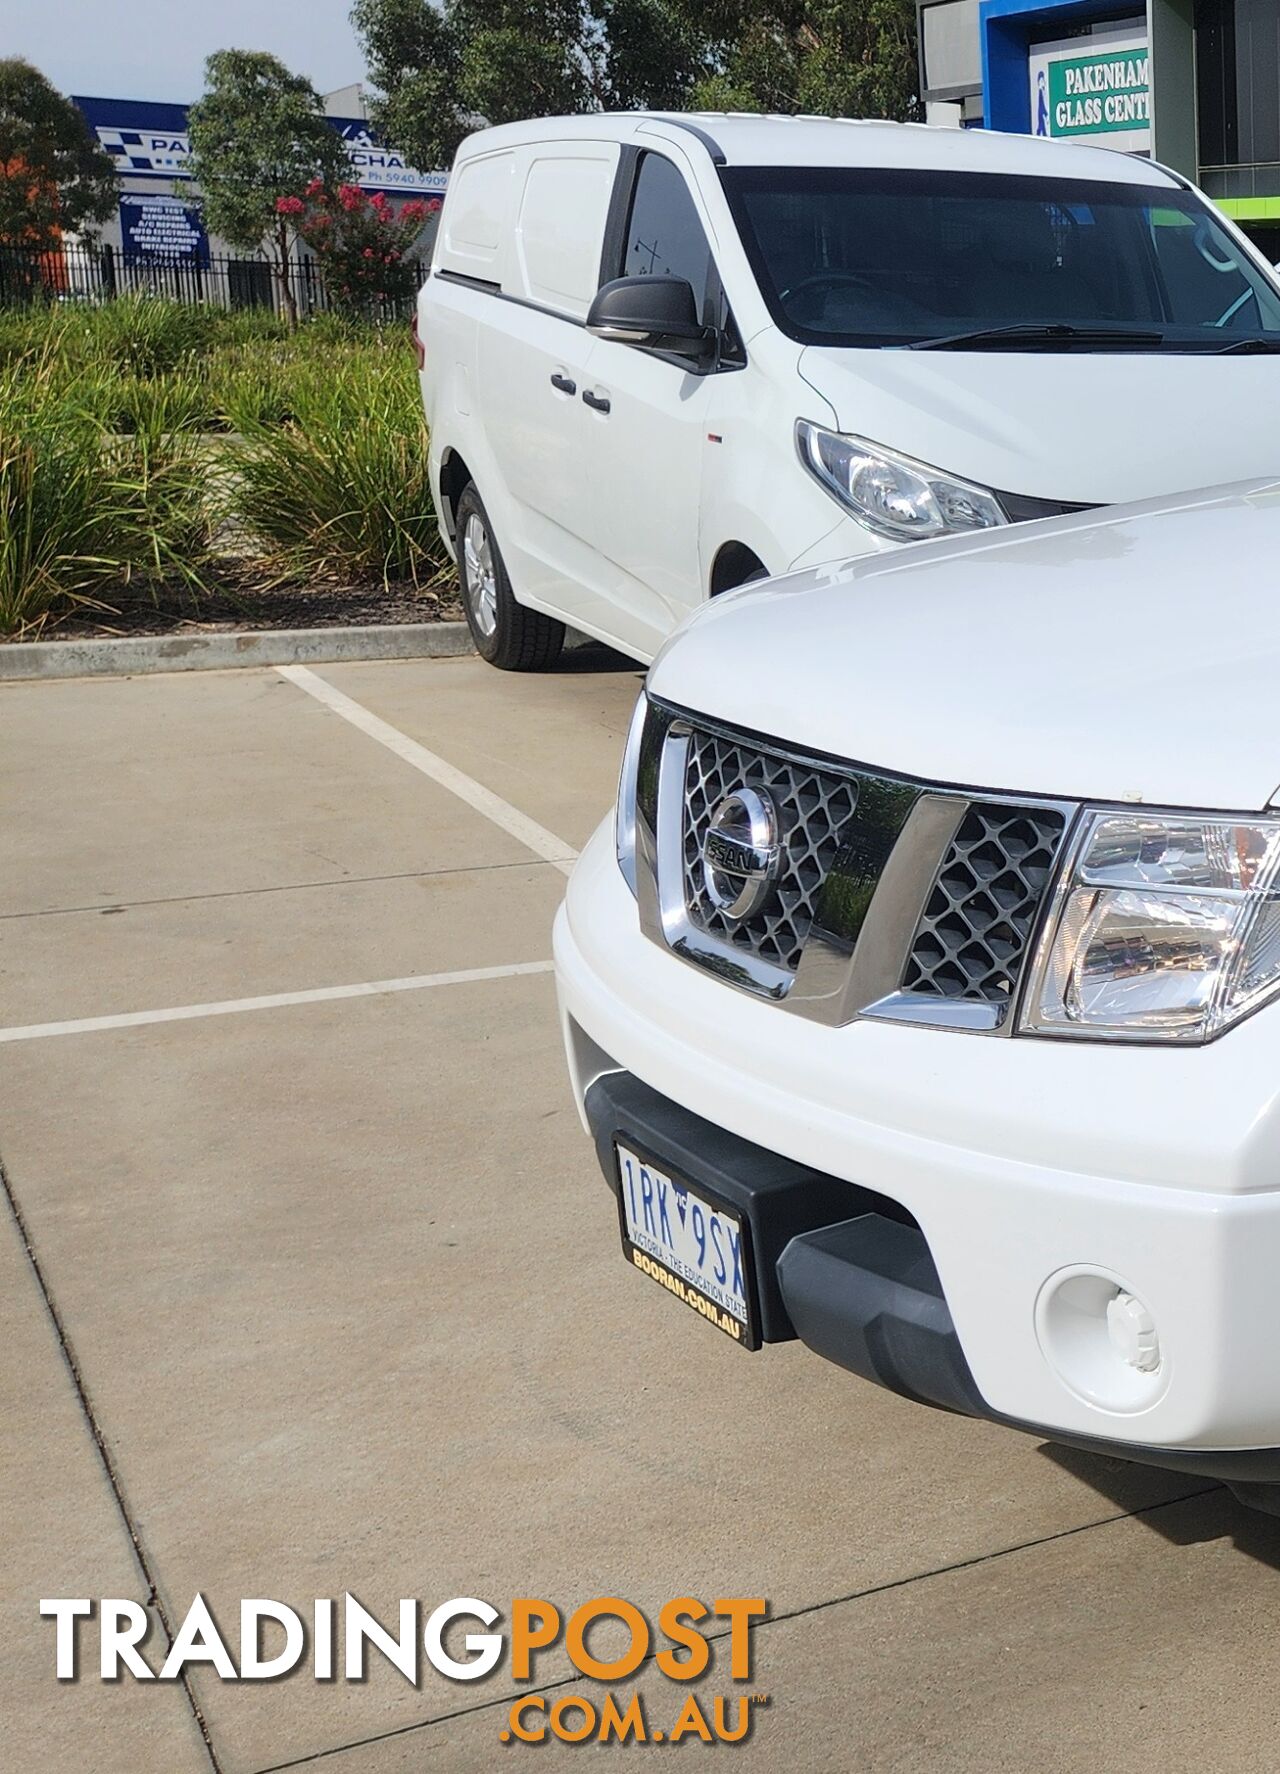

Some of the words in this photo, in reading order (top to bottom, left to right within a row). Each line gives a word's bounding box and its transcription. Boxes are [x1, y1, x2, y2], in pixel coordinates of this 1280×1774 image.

[1065, 58, 1149, 95] PAKENHAM
[1056, 98, 1102, 128] GLASS
[152, 139, 192, 153] PA
[386, 173, 415, 184] 5940
[418, 176, 447, 186] 9909
[625, 1159, 675, 1251] 1RK
[692, 1204, 745, 1296] 9SX
[632, 1229, 663, 1260] VICTORIA
[669, 1254, 684, 1274] THE
[684, 1265, 723, 1303] EDUCATION
[725, 1292, 748, 1319] STATE
[633, 1248, 740, 1339] BOORAN.COM.AU
